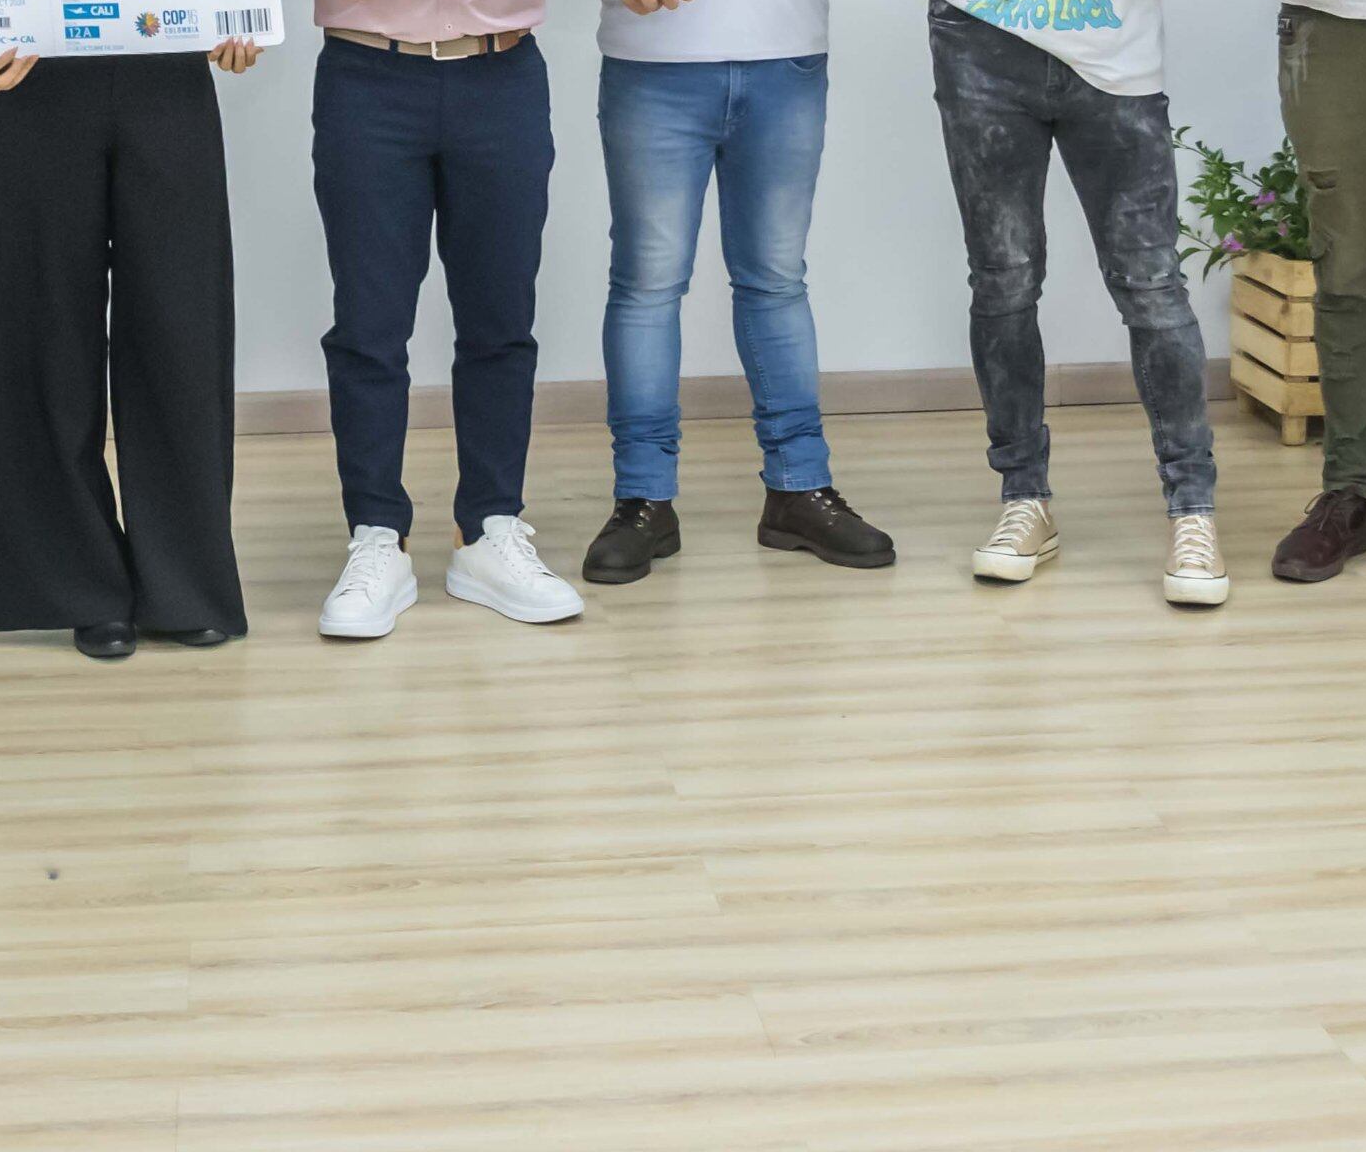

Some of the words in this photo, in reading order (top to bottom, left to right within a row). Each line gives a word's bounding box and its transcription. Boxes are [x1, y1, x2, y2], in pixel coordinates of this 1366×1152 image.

[90, 6, 114, 16] CALI
[162, 9, 198, 25] COP16
[164, 26, 199, 34] COLOMBIA
